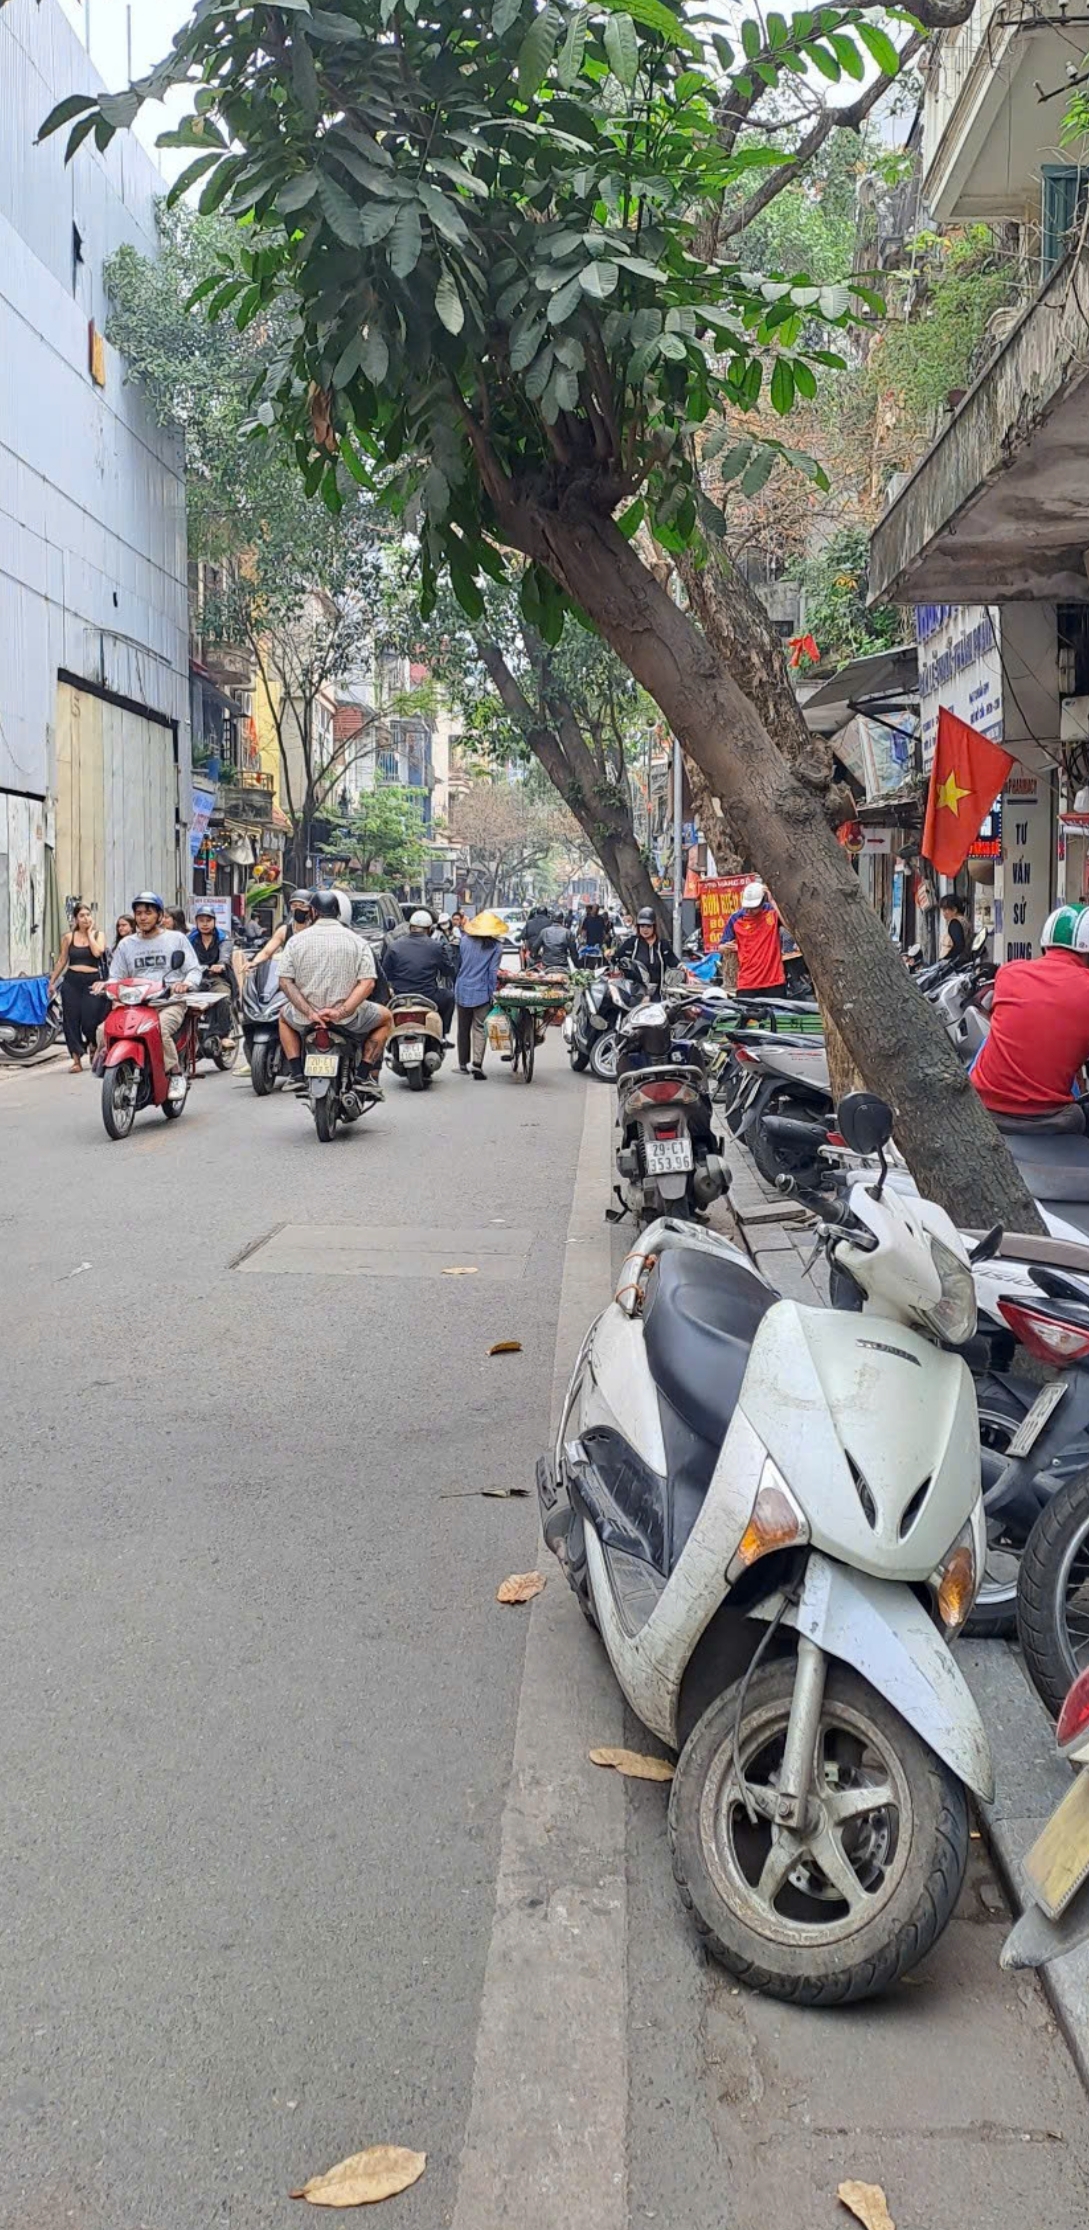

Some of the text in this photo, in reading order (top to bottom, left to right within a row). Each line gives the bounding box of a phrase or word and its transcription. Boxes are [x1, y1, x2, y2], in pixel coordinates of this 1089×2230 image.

[1015, 821, 1028, 845] TƯ
[1012, 855, 1031, 884] VẤN
[652, 1141, 685, 1157] 29-C1
[649, 1156, 690, 1172] 353.96
